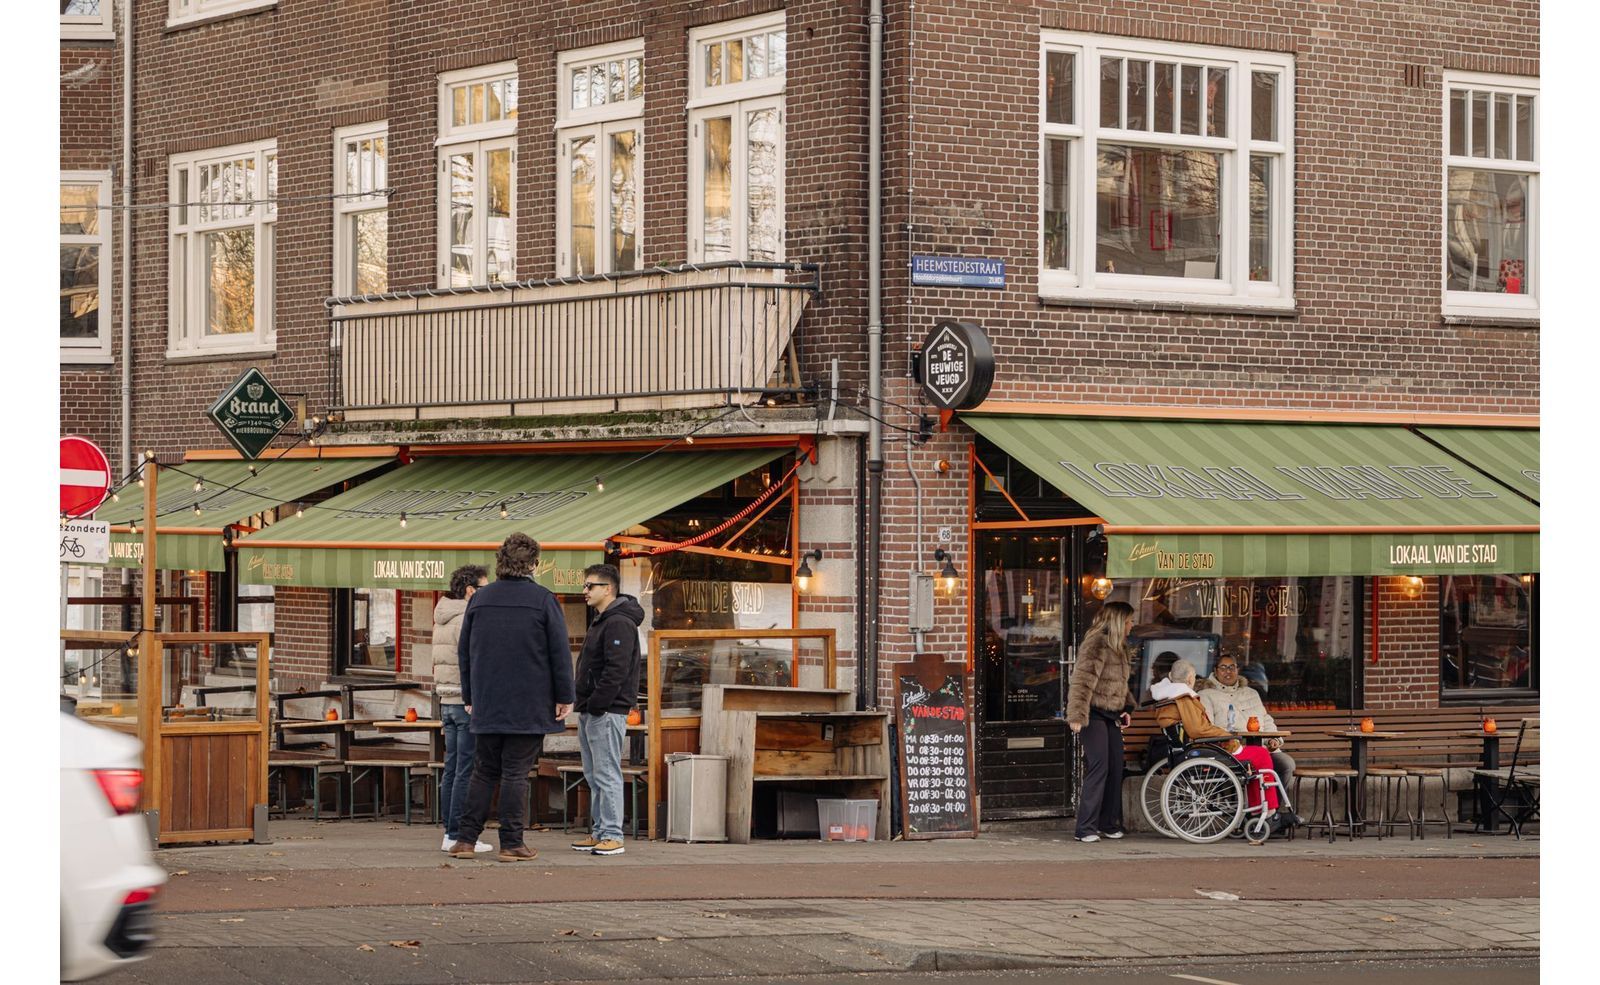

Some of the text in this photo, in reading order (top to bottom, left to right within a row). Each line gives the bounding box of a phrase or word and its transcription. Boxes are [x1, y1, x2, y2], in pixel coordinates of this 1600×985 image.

[916, 259, 1002, 275] HEEMSTEDESTRAAT
[942, 350, 952, 361] DE
[930, 361, 964, 374] EEUWIGE
[935, 374, 960, 385] JEUGD
[230, 396, 280, 415] Brand
[1057, 461, 1307, 501] LOKAAL
[1274, 465, 1424, 500] VAN
[1387, 465, 1498, 499] DE
[941, 529, 951, 540] 68
[133, 542, 144, 558] STA
[1390, 544, 1498, 564] LOKAAL VAN DE STAD
[1156, 550, 1215, 570] VAN DE STAD
[373, 560, 445, 578] LOKAAL VAN DE STAD
[682, 581, 765, 614] VAN DE STAD
[1199, 579, 1308, 618] VAN DE STAD
[905, 744, 915, 754] DI
[907, 766, 919, 776] DO
[907, 778, 919, 788] VR
[908, 790, 919, 801] ZA
